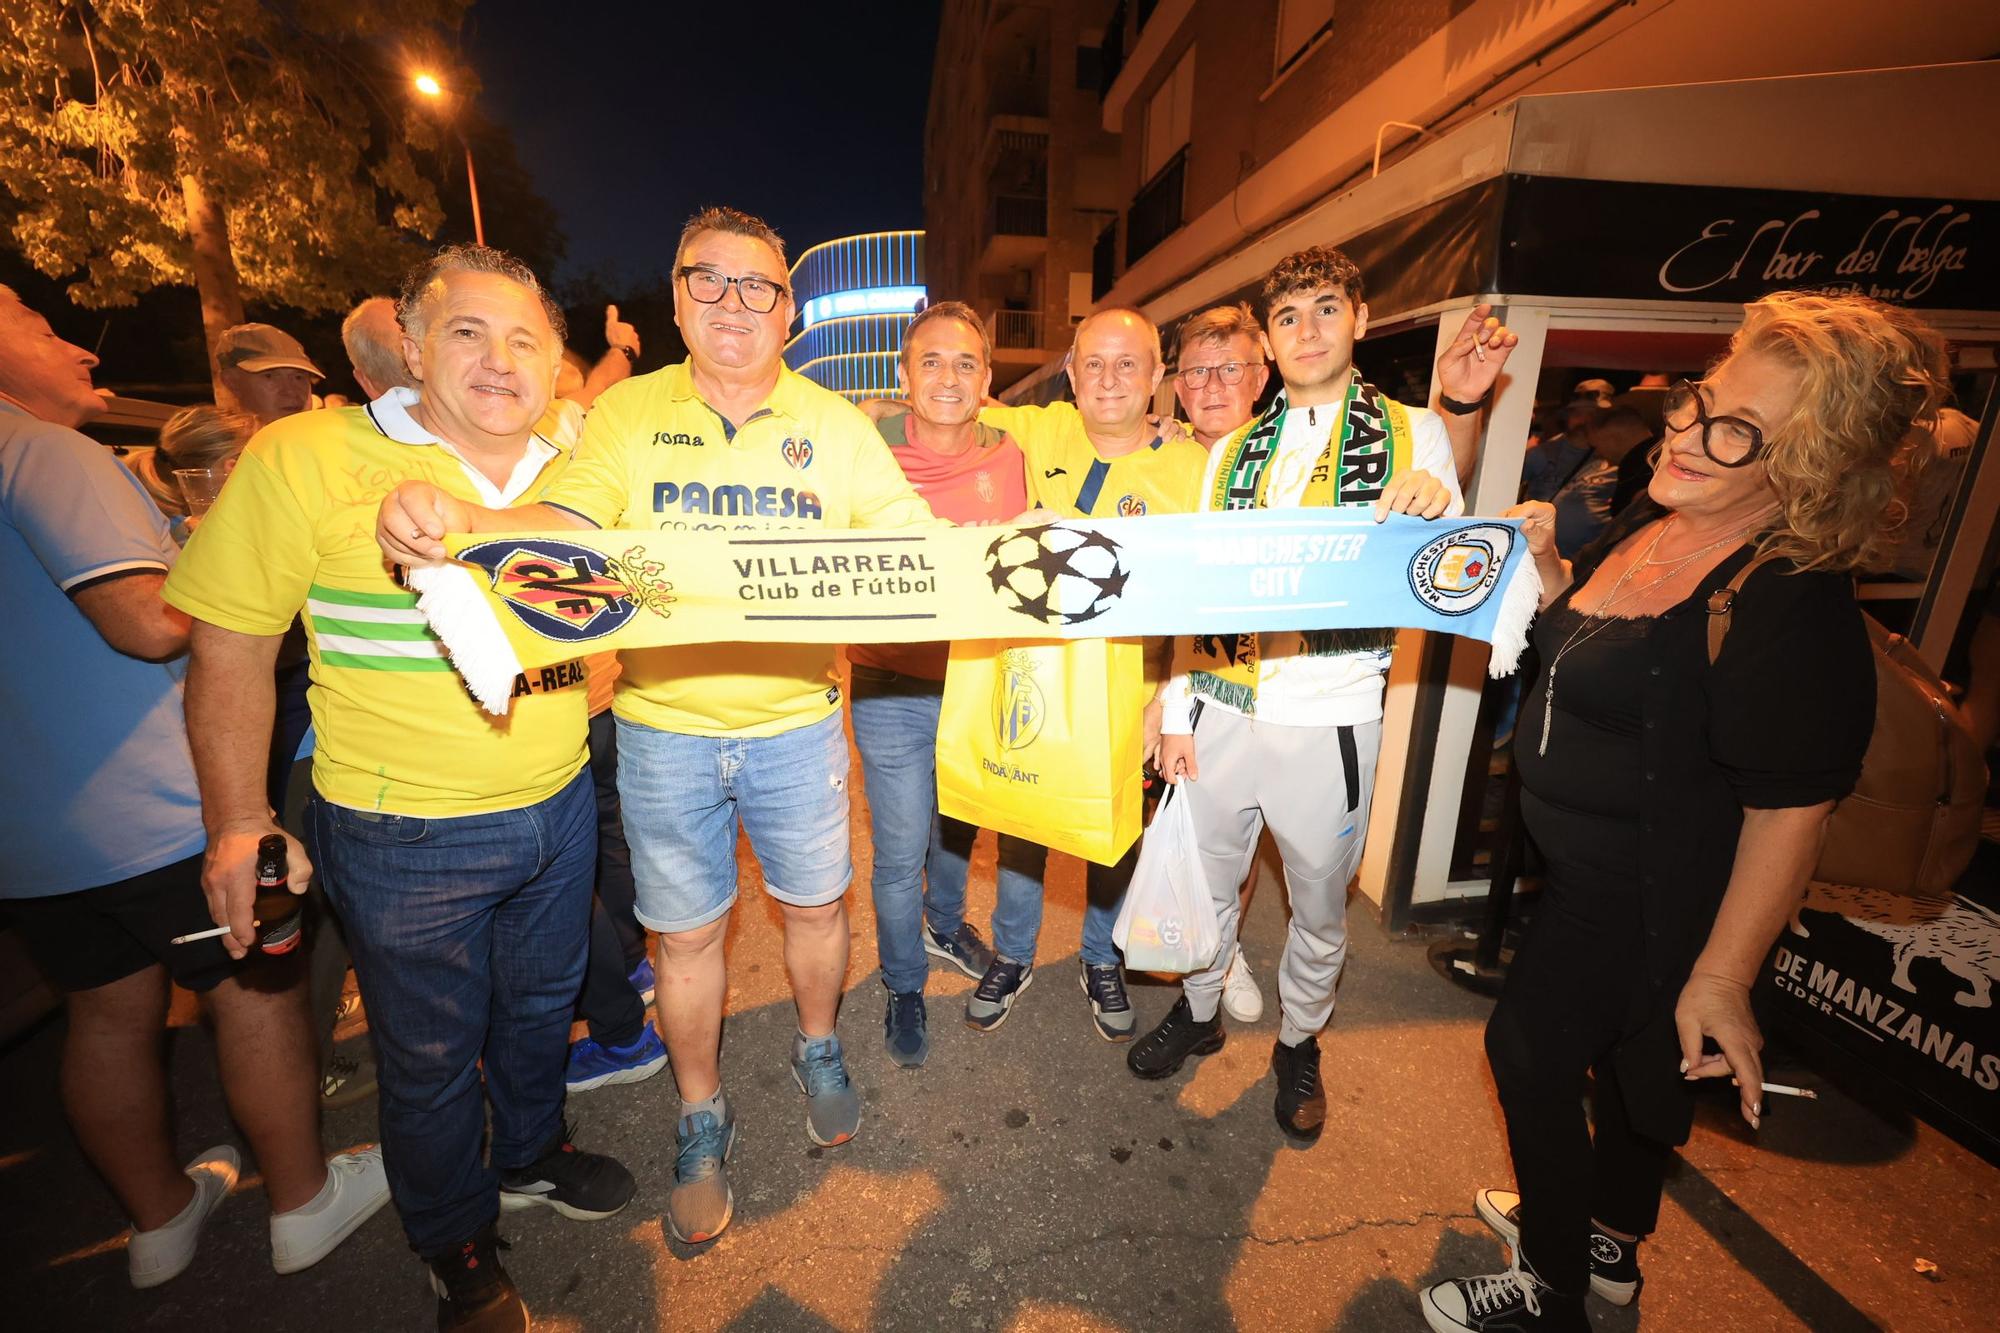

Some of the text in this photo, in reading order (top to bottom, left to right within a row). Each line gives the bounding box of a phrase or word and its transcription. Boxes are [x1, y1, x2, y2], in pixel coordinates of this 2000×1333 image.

[1659, 204, 1971, 299] El bar del belga
[652, 481, 823, 521] PAMESA
[733, 554, 936, 579] VILLARREAL
[1250, 565, 1306, 598] CITY
[1415, 531, 1469, 603] MANCHESTER
[1484, 555, 1502, 589] CITY
[738, 576, 937, 600] Club de Fútbol
[509, 660, 585, 699] A-REAL
[982, 757, 1039, 785] ENDAVANT
[1774, 975, 1834, 1016] CIDER
[1773, 946, 2000, 1091] DE MANZANAS
